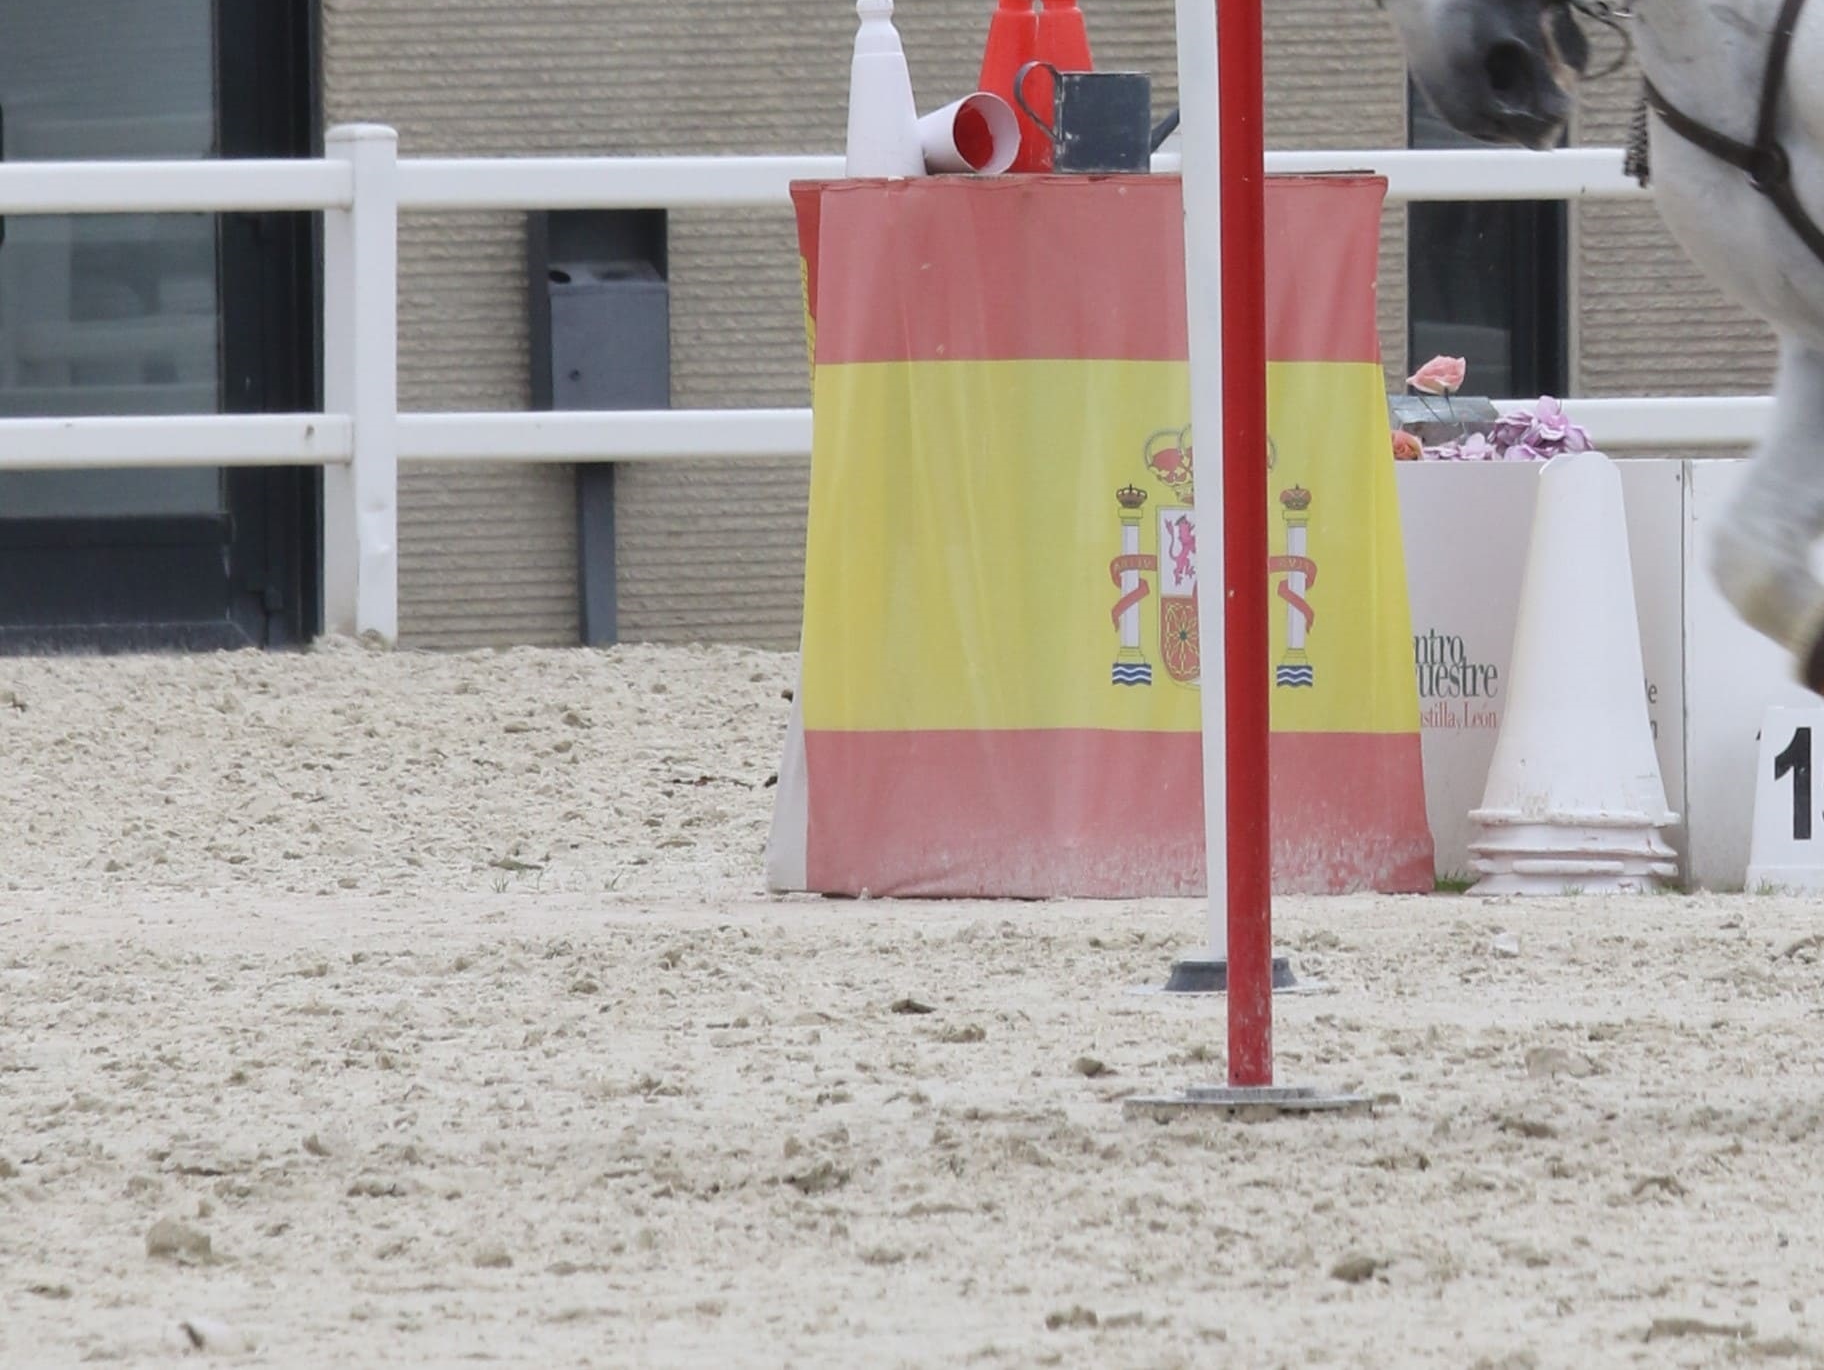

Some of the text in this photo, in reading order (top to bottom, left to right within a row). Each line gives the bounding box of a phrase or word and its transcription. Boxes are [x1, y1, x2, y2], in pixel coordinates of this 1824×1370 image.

[1414, 628, 1466, 664] ntro
[1417, 657, 1499, 699] uestre
[1464, 701, 1498, 729] León
